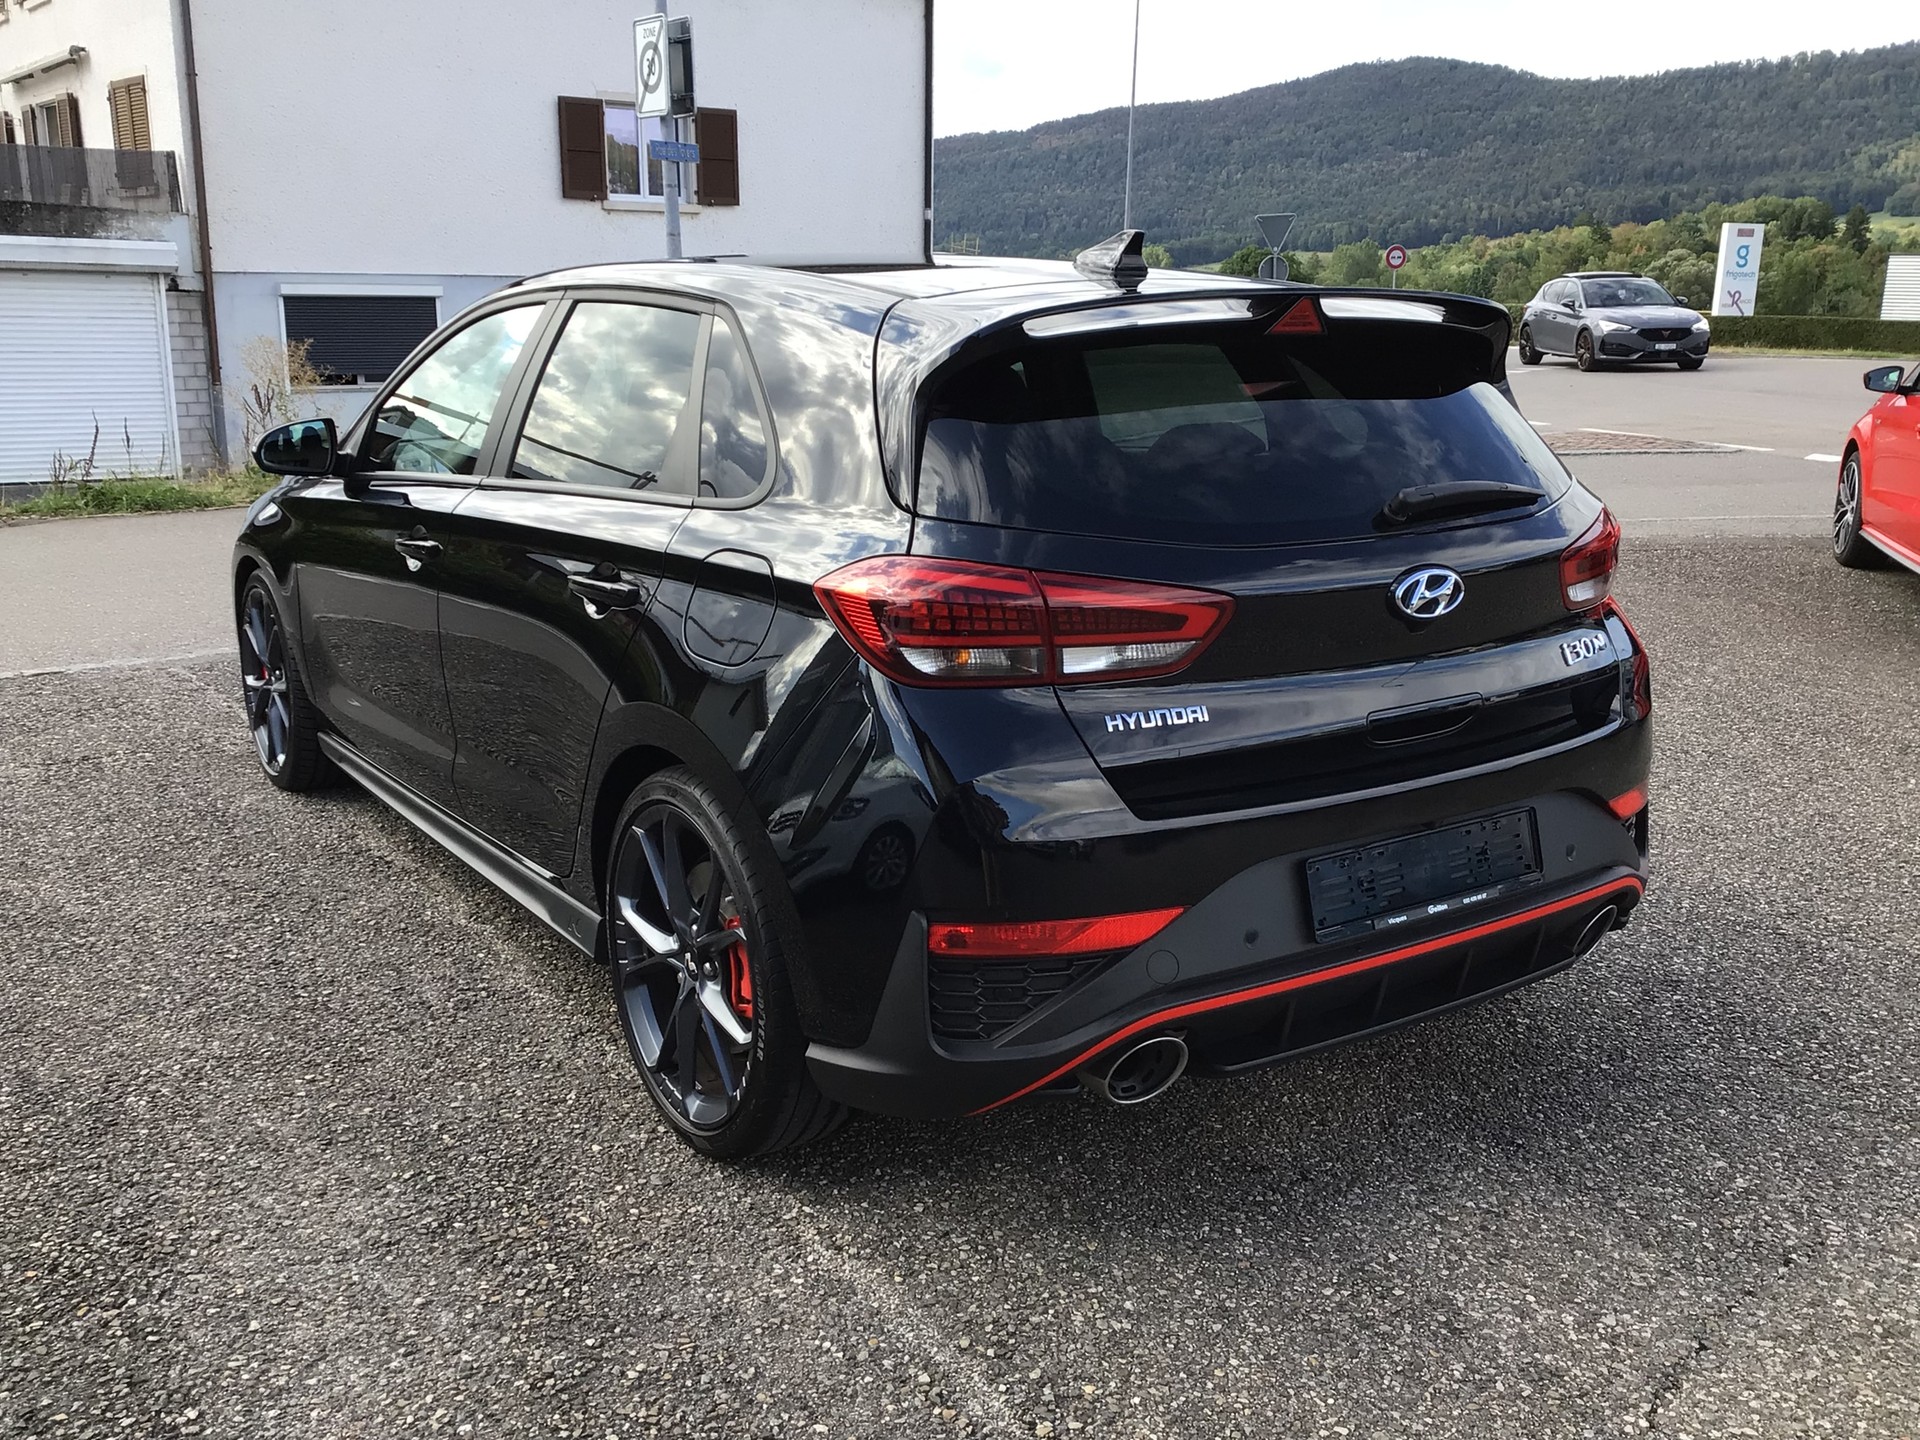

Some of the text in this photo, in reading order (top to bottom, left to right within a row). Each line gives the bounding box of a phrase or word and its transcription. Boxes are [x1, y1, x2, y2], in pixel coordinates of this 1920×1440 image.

[643, 26, 656, 39] ZONE
[1104, 705, 1209, 732] HYUNDAI
[754, 963, 766, 1061] GOODYEAR
